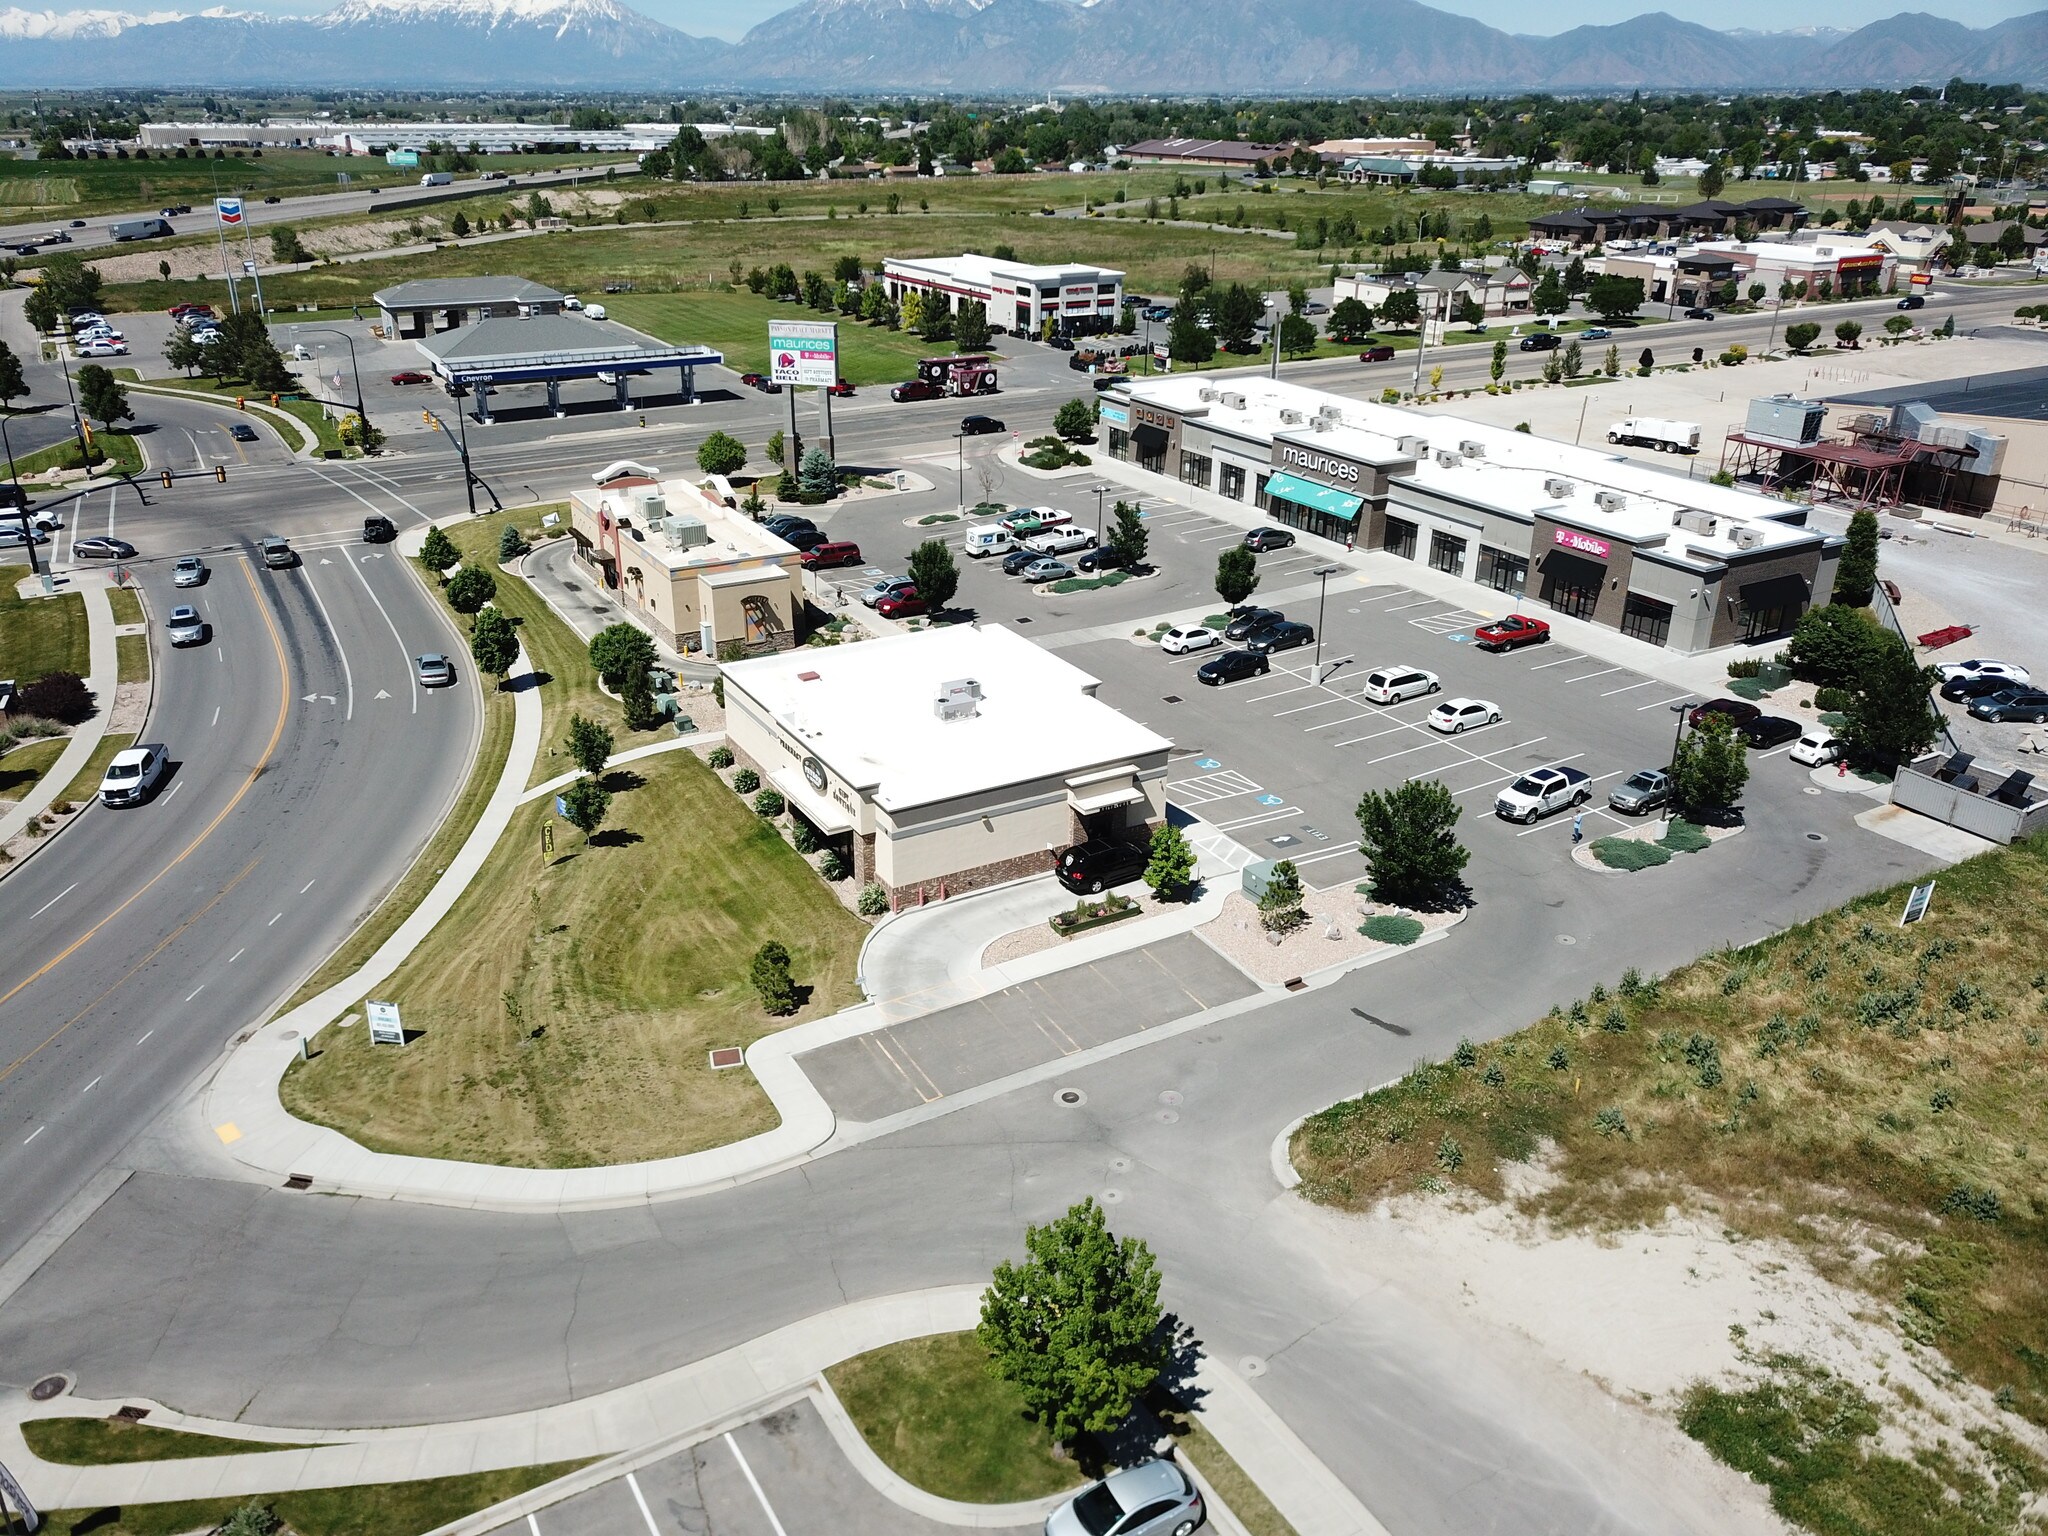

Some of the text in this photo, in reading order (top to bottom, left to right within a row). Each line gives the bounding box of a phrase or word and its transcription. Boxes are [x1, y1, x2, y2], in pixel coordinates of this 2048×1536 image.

[773, 338, 831, 350] maurices
[461, 374, 493, 383] Chevron
[1283, 446, 1359, 482] maurices
[545, 826, 553, 852] CBD
[1306, 828, 1329, 841] EXIT
